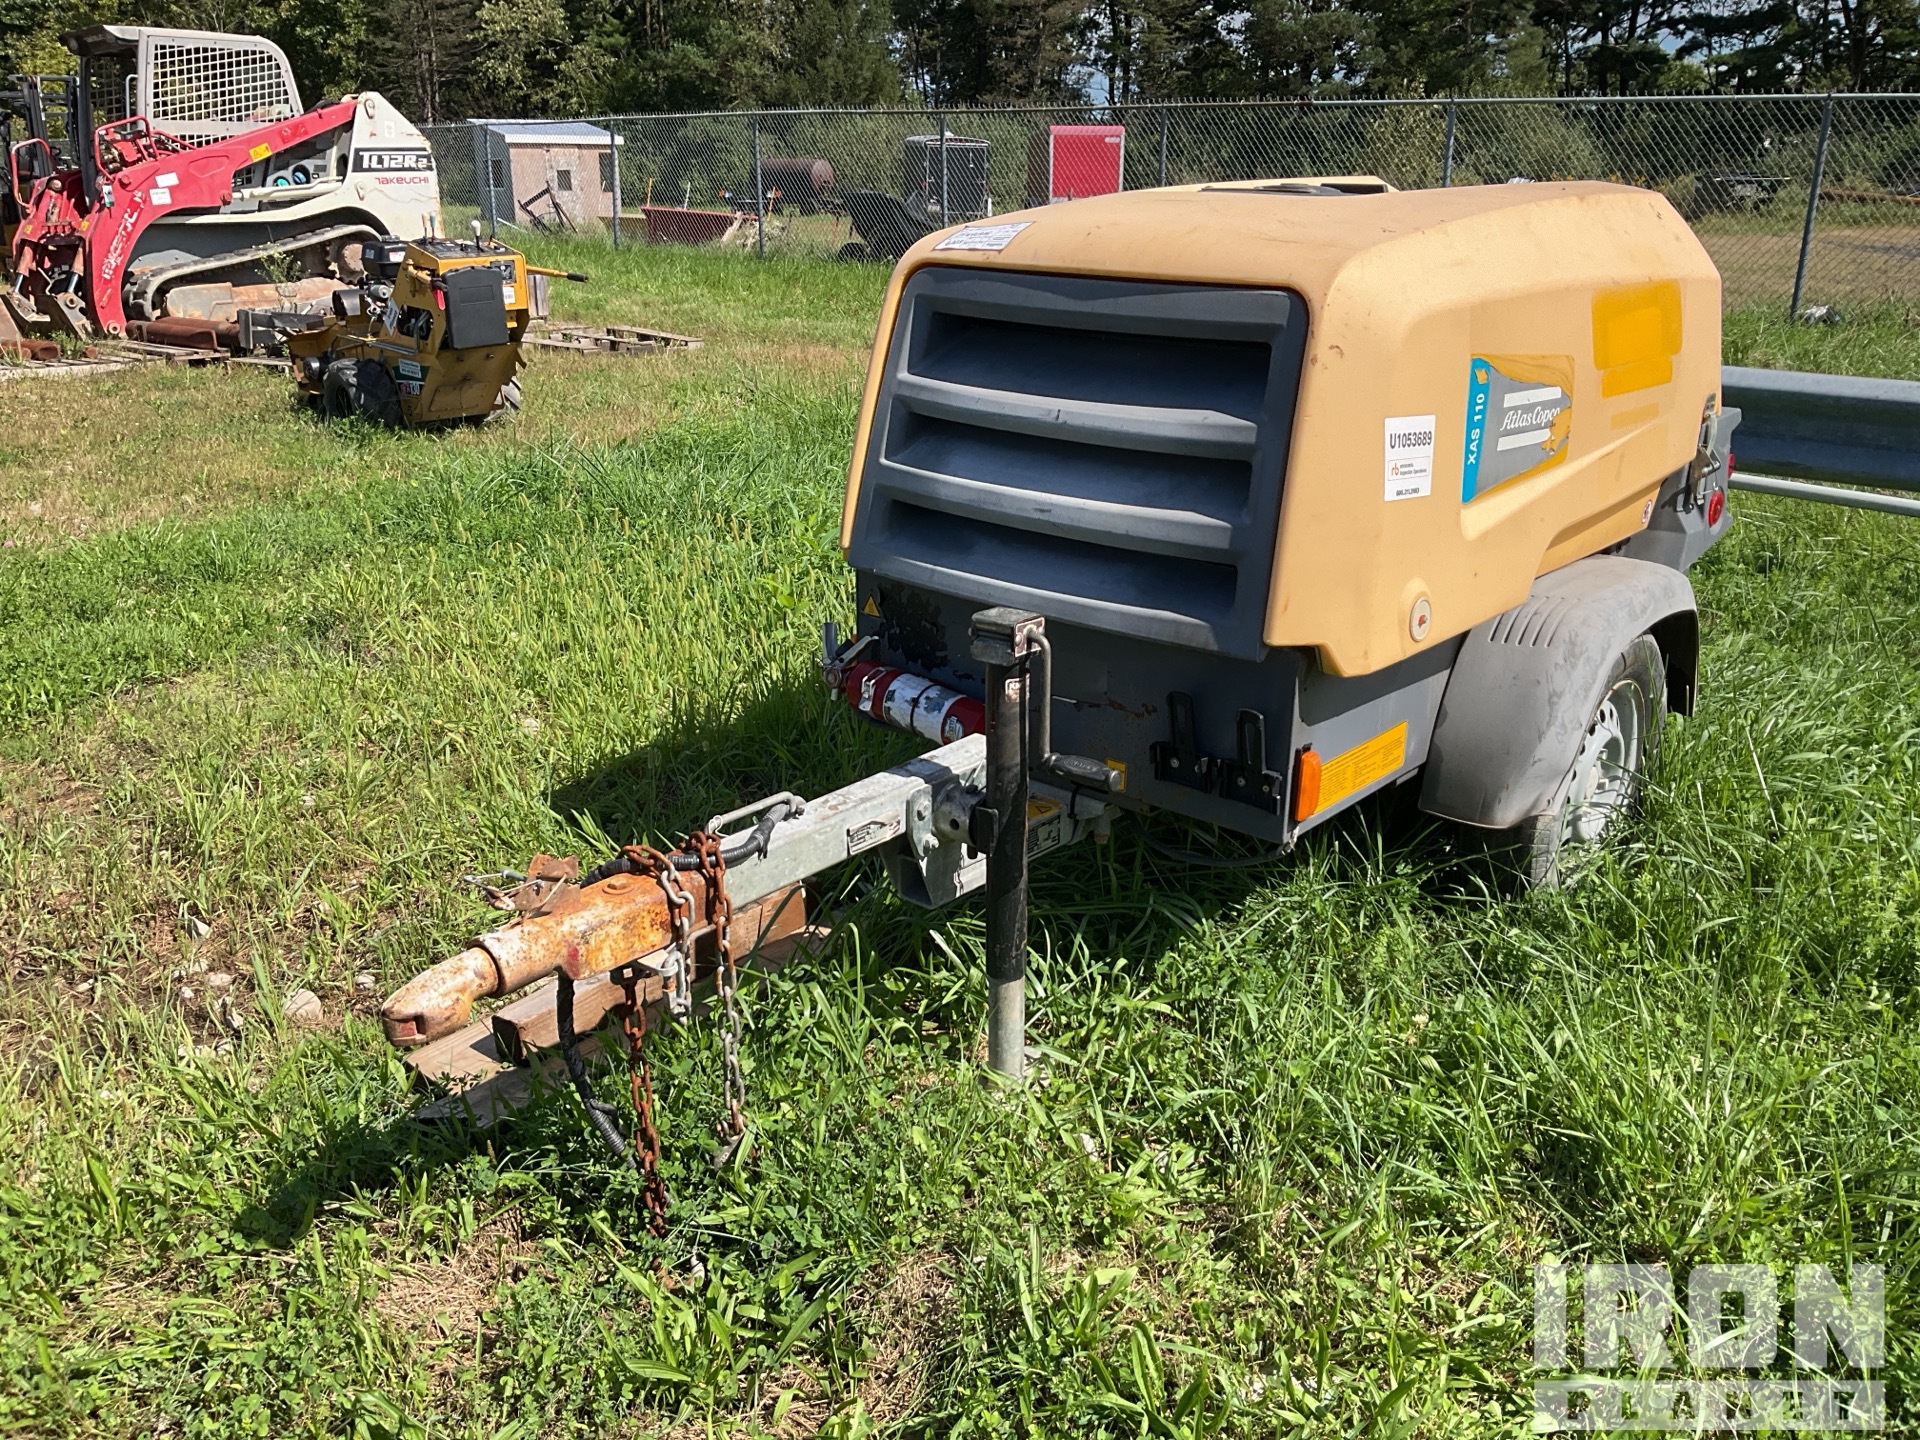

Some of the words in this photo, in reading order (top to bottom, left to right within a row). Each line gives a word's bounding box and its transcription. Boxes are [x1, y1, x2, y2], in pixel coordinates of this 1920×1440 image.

[375, 176, 429, 185] TAKEUCHI
[1473, 393, 1485, 422] 110
[1500, 410, 1532, 431] Atlas
[1389, 430, 1433, 450] U1053689
[1467, 428, 1480, 465] XAS
